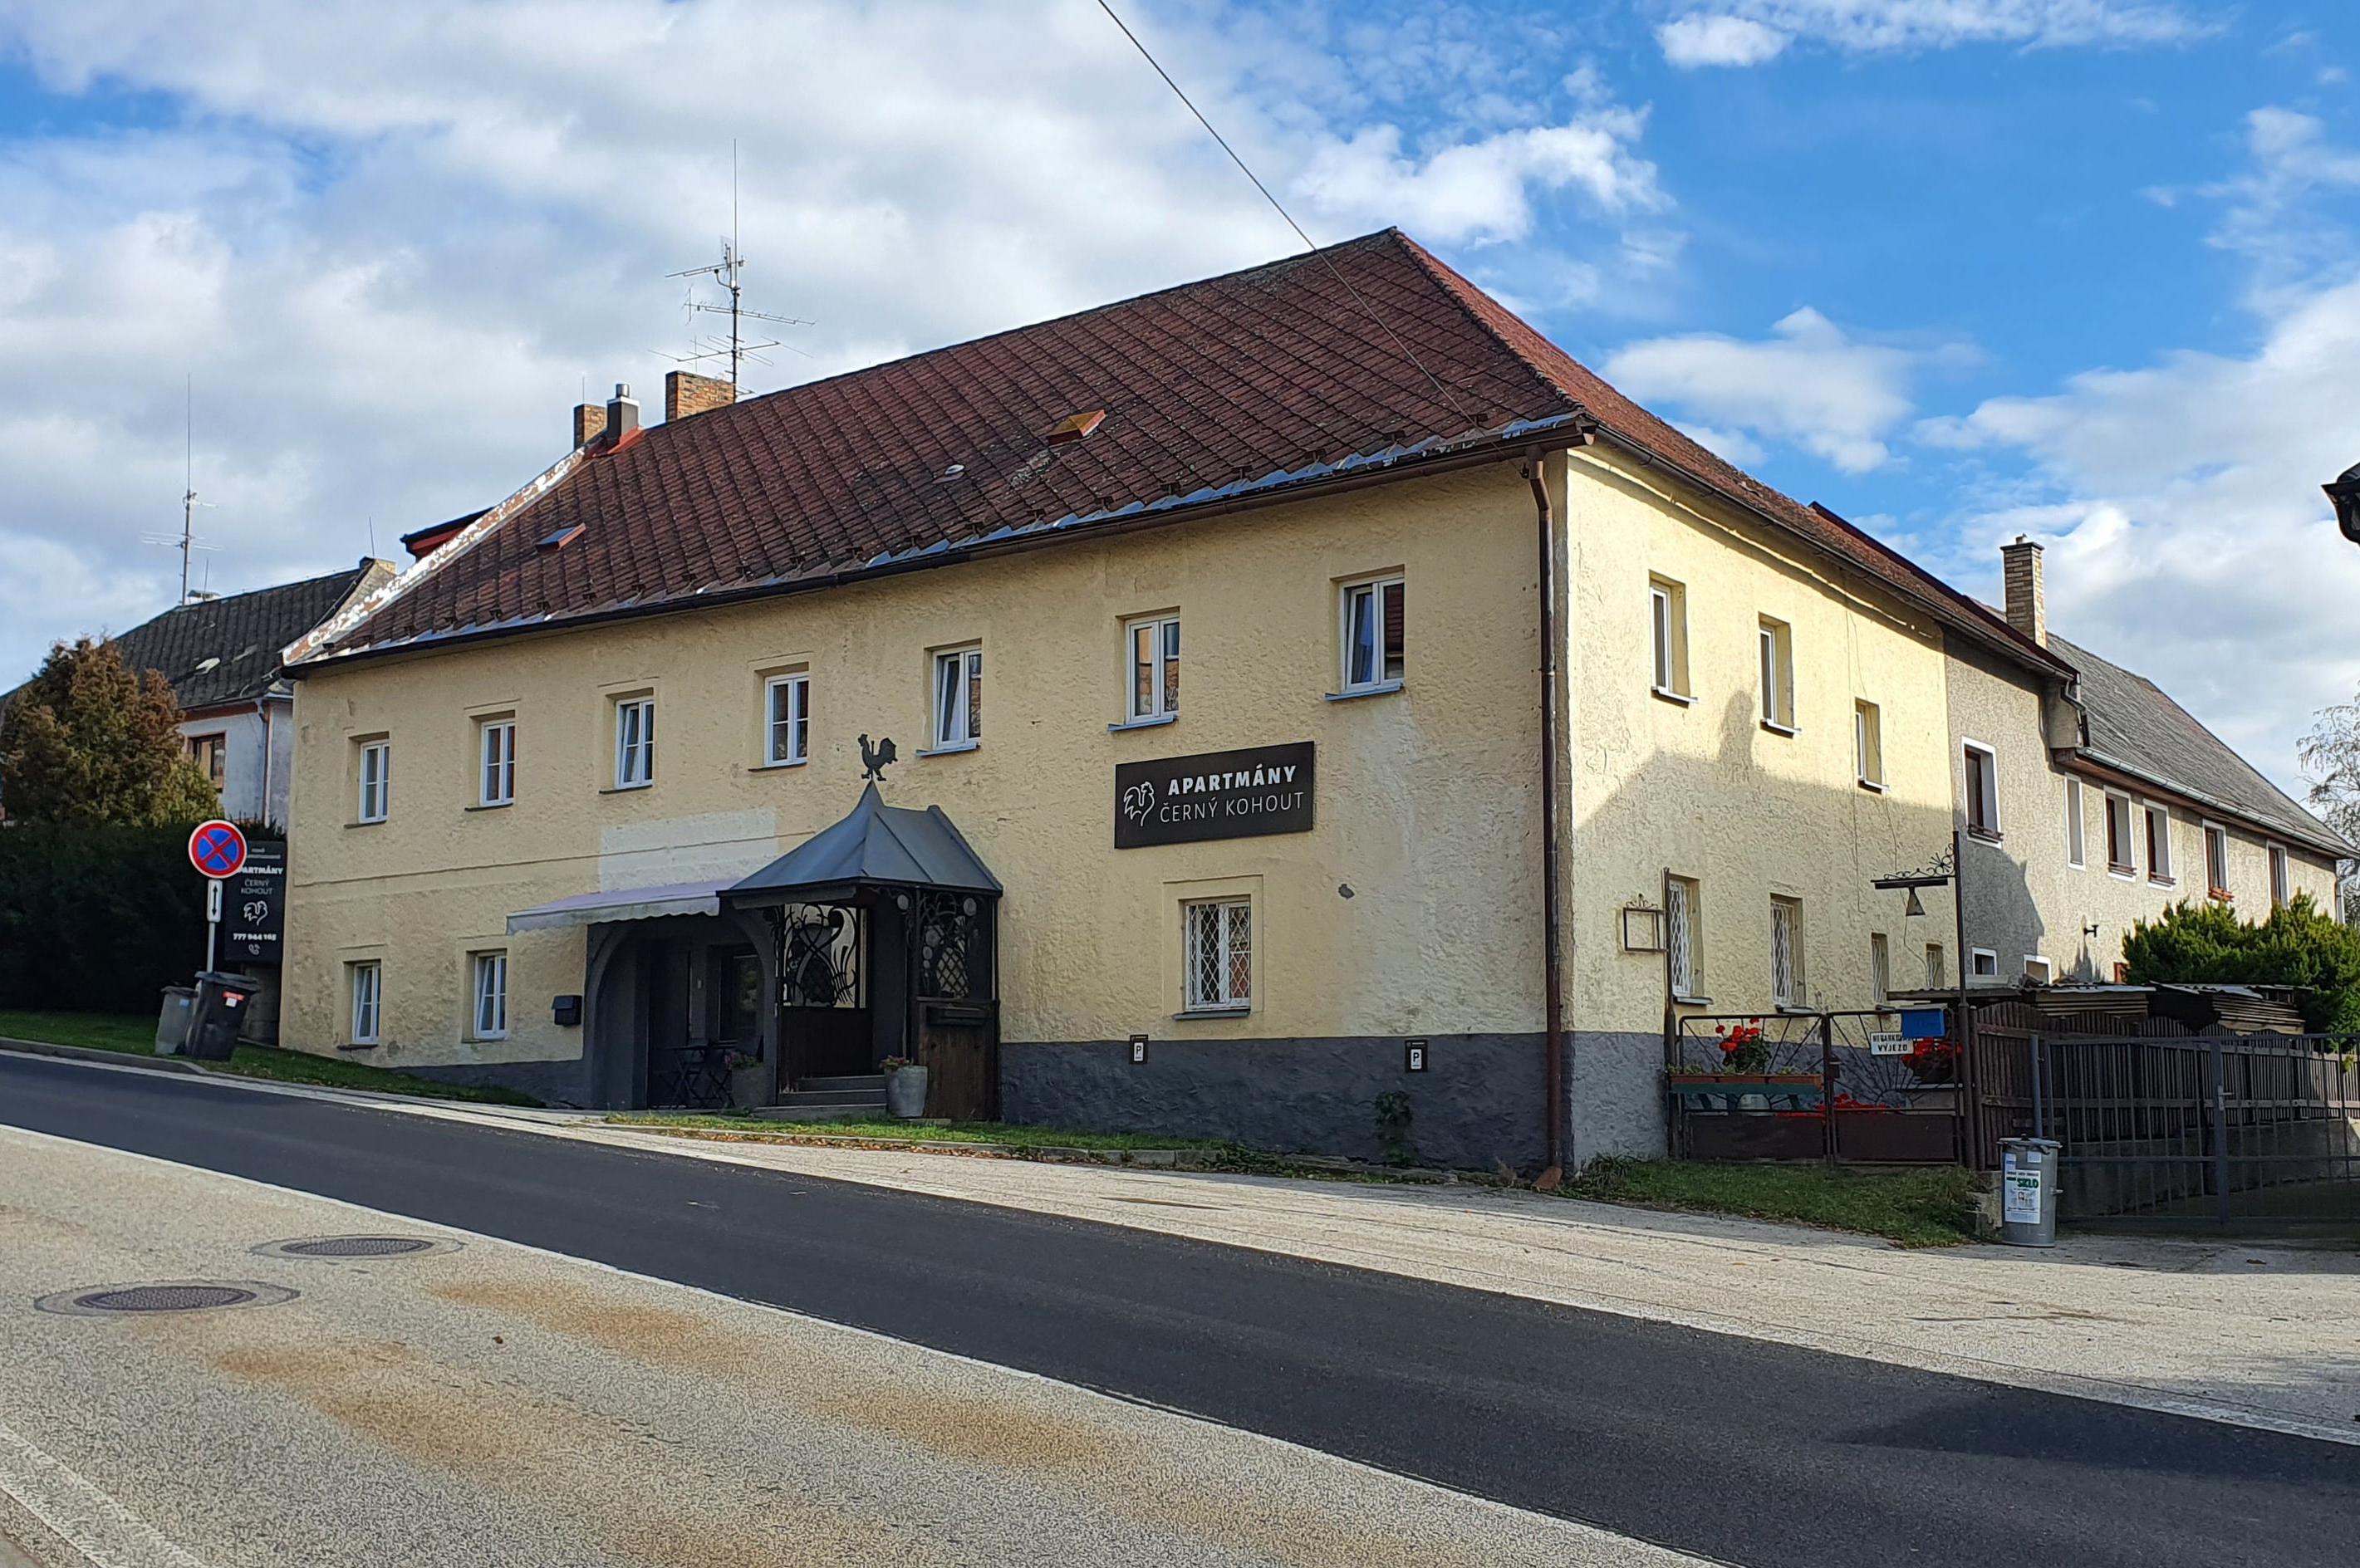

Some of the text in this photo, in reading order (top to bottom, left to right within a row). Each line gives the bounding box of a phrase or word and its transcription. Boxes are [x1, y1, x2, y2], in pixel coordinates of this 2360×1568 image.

[1168, 763, 1297, 796] APARTMÁNY
[1160, 791, 1304, 823] ČERNÝ KOHOUT
[244, 877, 270, 887] ČERNÝ
[233, 933, 247, 941] 777
[1136, 1045, 1142, 1055] P
[1413, 1051, 1420, 1062] P
